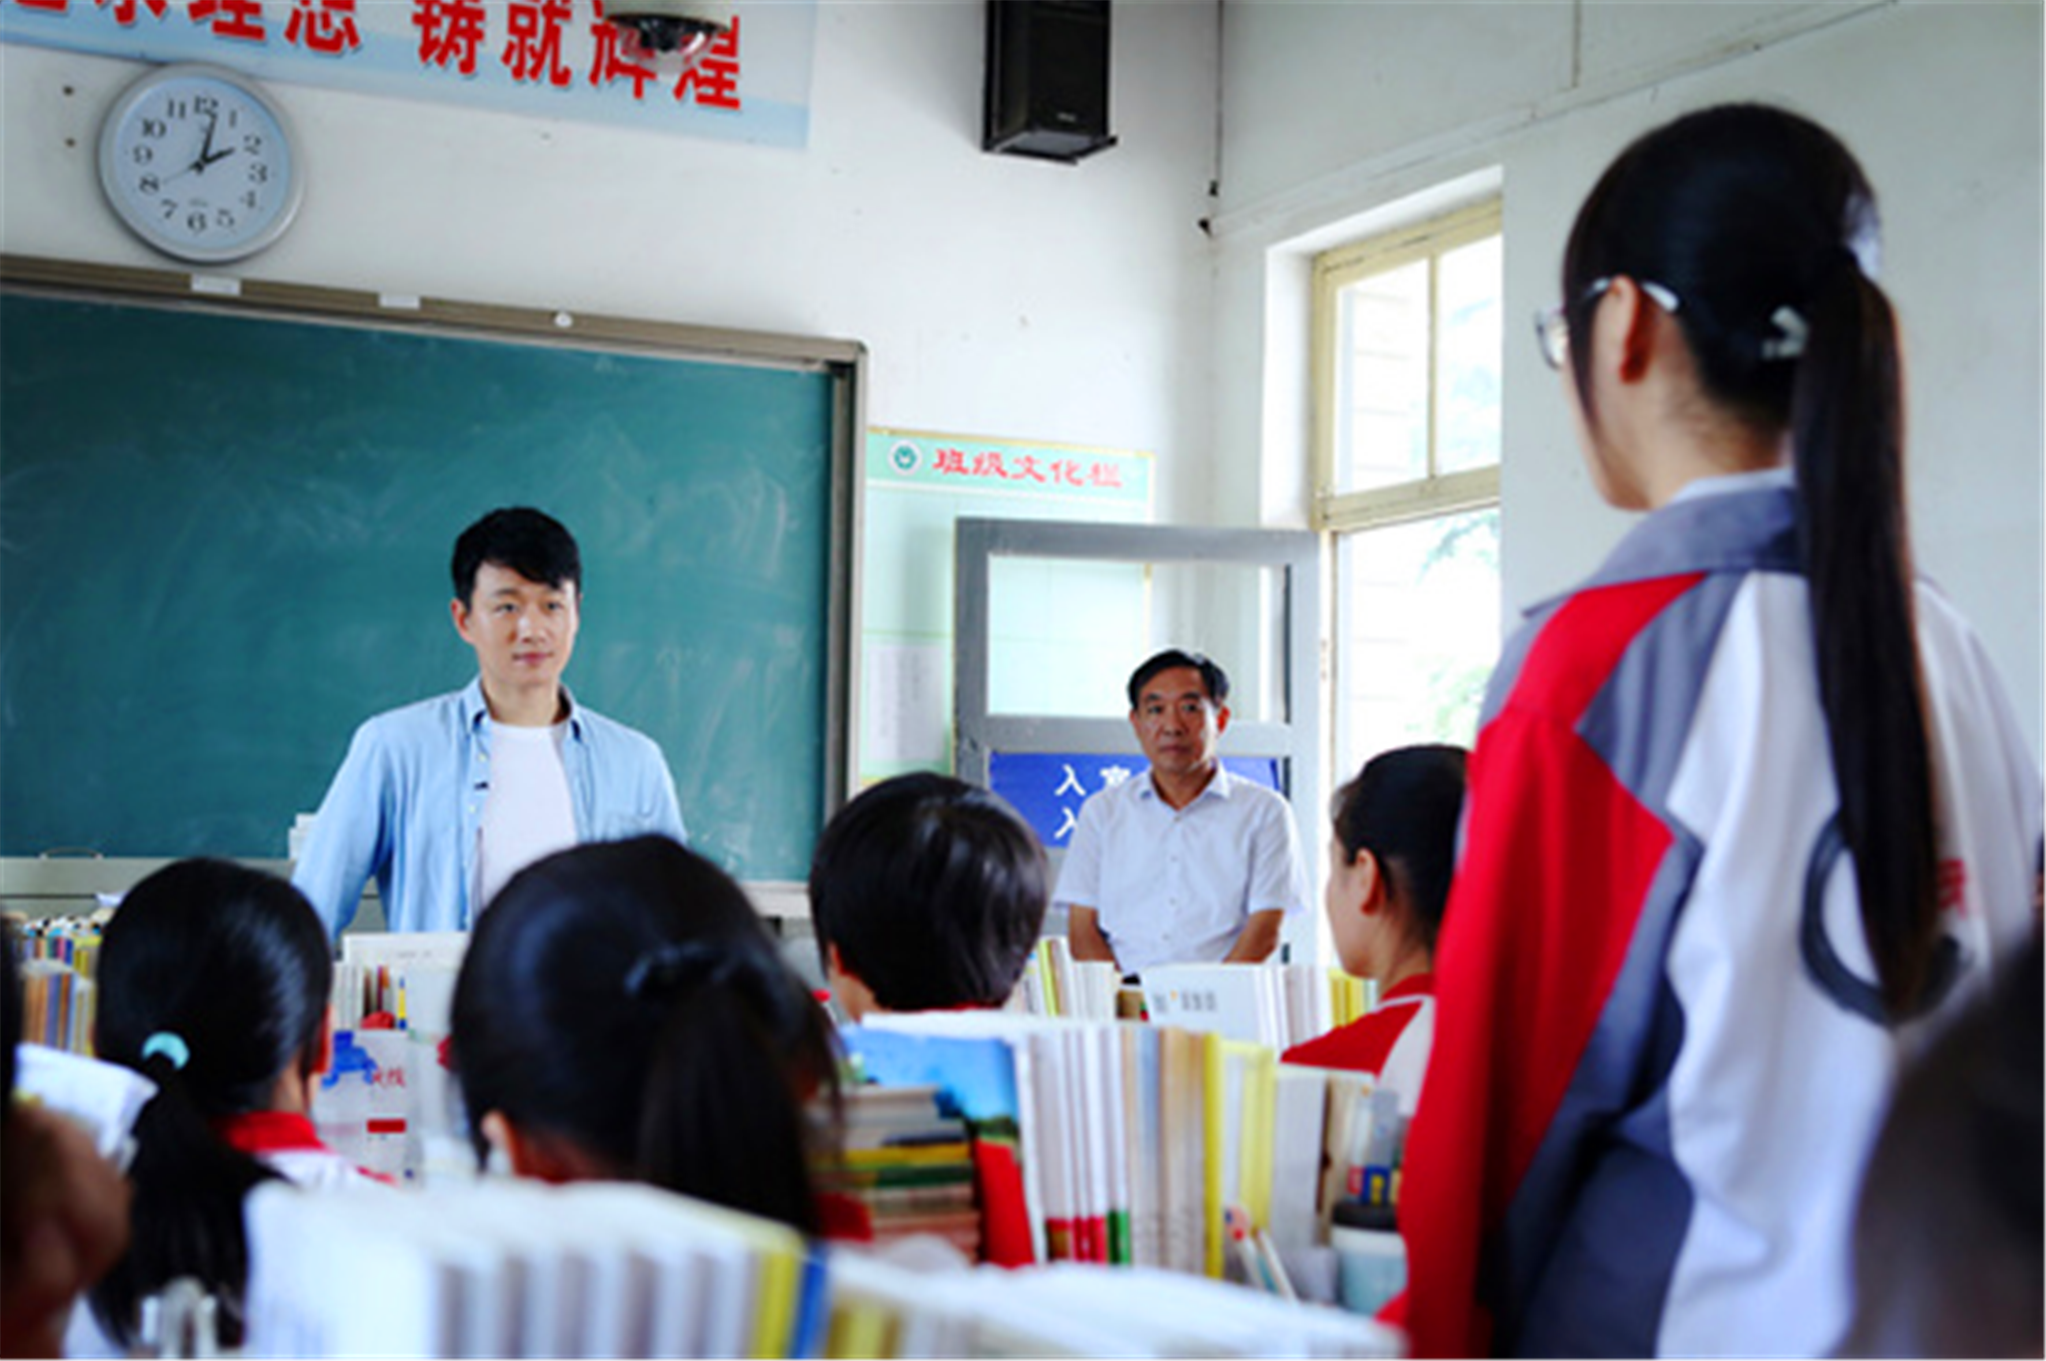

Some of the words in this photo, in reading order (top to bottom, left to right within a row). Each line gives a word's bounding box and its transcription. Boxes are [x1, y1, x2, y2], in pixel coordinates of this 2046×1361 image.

[14, 0, 362, 54] 理想
[166, 98, 187, 120] 11
[141, 118, 167, 138] 10
[133, 144, 152, 165] 9
[243, 134, 262, 155] 2
[139, 173, 160, 195] 8
[248, 162, 268, 184] 3
[161, 199, 178, 219] 7
[216, 208, 235, 228] 5
[187, 211, 208, 233] 6
[932, 447, 1124, 489] 班级文化栏
